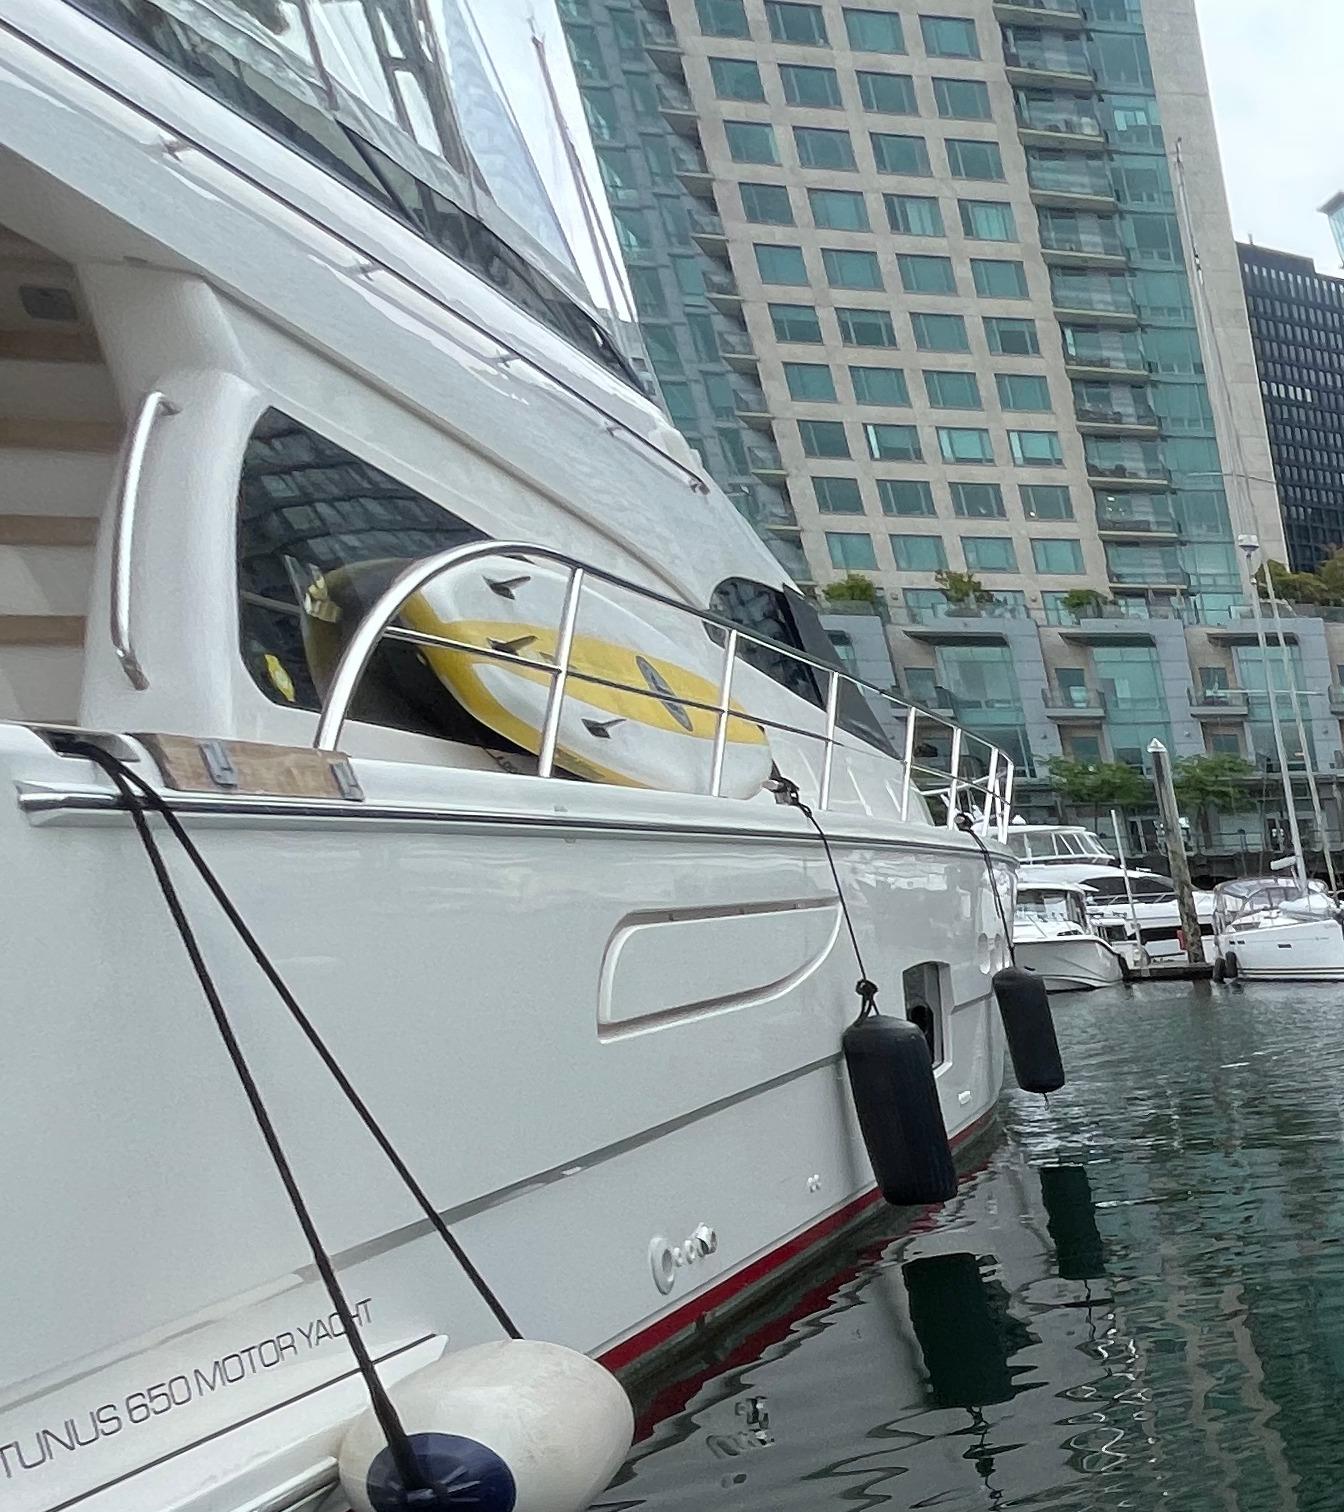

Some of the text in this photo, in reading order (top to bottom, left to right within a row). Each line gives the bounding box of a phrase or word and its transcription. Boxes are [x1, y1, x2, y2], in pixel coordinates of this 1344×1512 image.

[0, 1403, 122, 1479] TUNUS
[126, 1375, 192, 1425] 650
[194, 1331, 298, 1397] MOTOR
